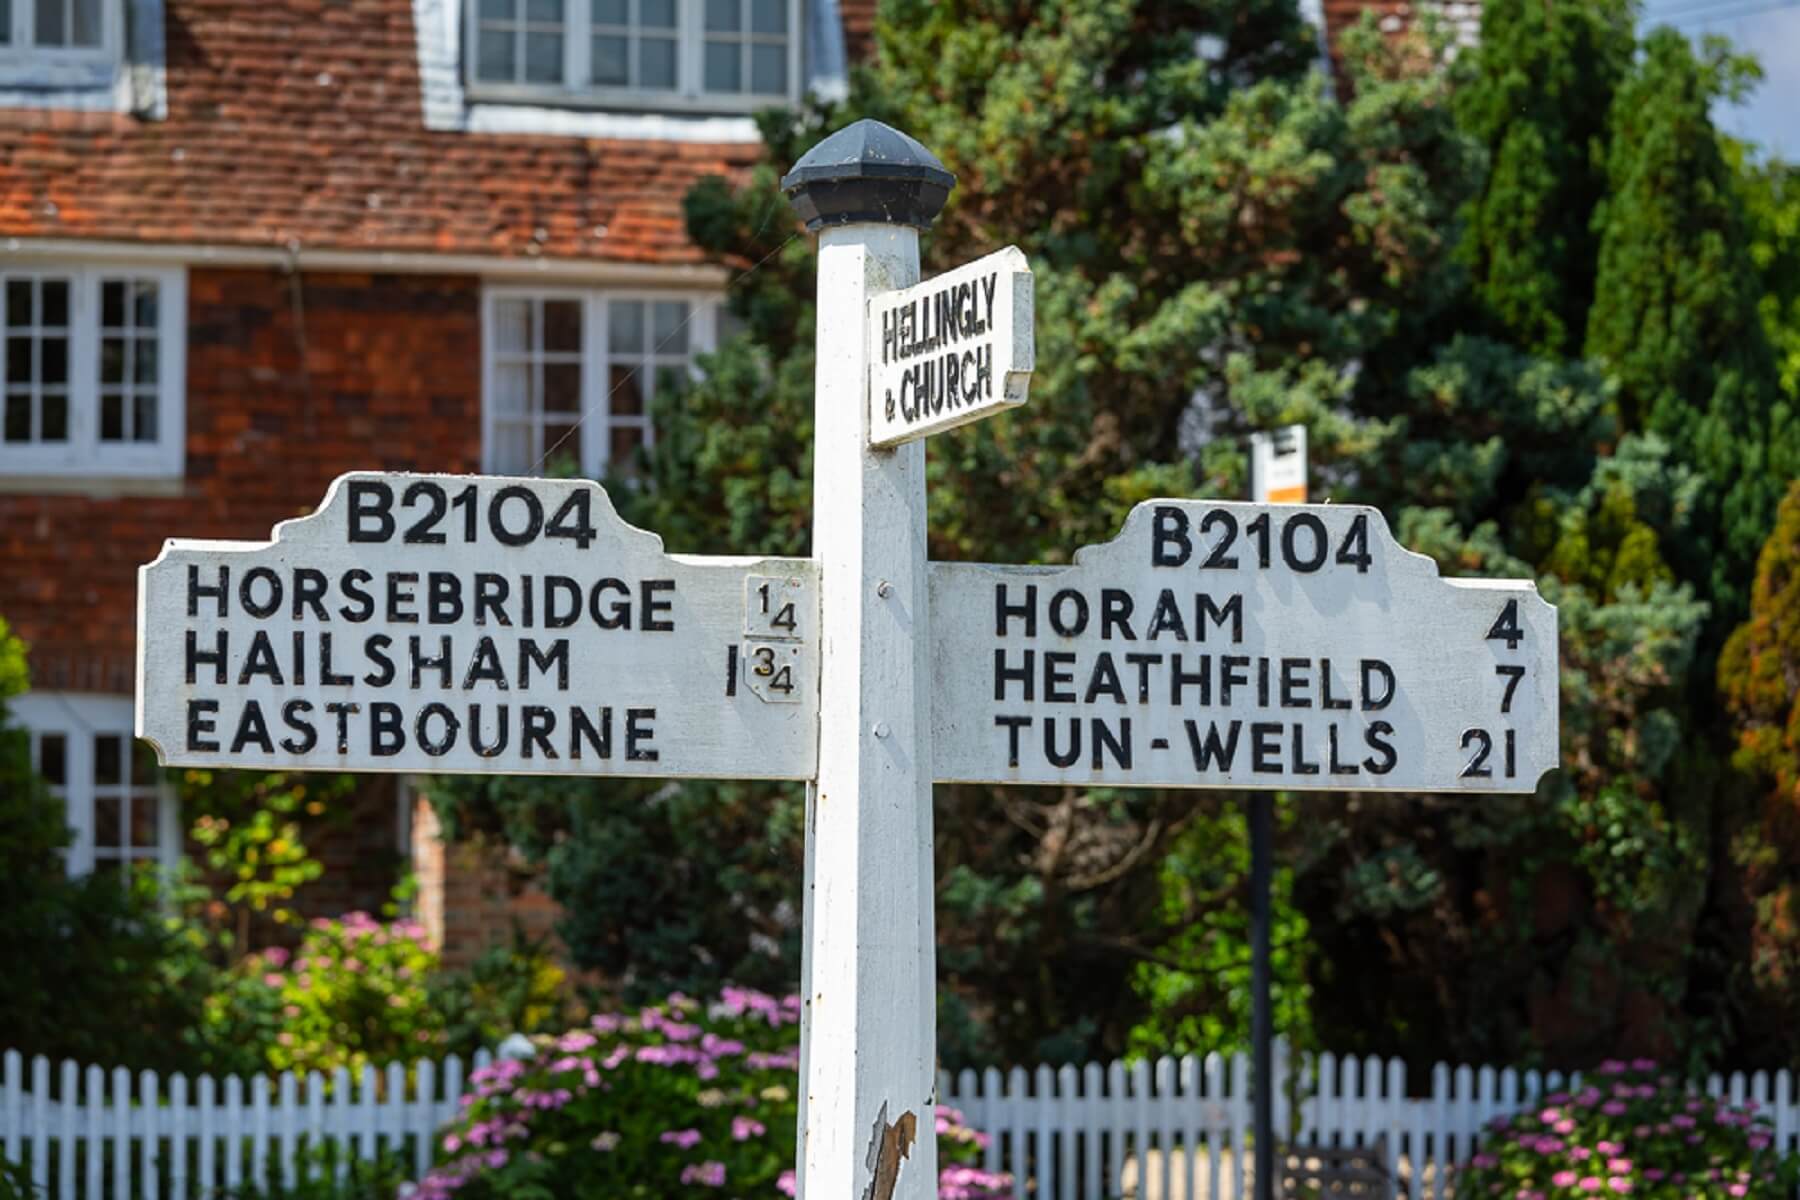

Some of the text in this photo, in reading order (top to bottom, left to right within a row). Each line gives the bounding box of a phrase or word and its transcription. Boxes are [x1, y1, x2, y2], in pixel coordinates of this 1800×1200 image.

[882, 271, 997, 367] HELLINGLY
[884, 342, 993, 425] & CHURCH
[347, 480, 597, 550] B2104
[1151, 505, 1372, 574] B2104
[185, 564, 676, 634] HORSEBRIDGE
[995, 582, 1525, 650] HORAM 4
[185, 629, 571, 691] HAILSHAM
[993, 648, 1526, 714] HEATHFIELD 7
[186, 699, 660, 762] EASTBOURNE
[1459, 728, 1516, 779] 21
